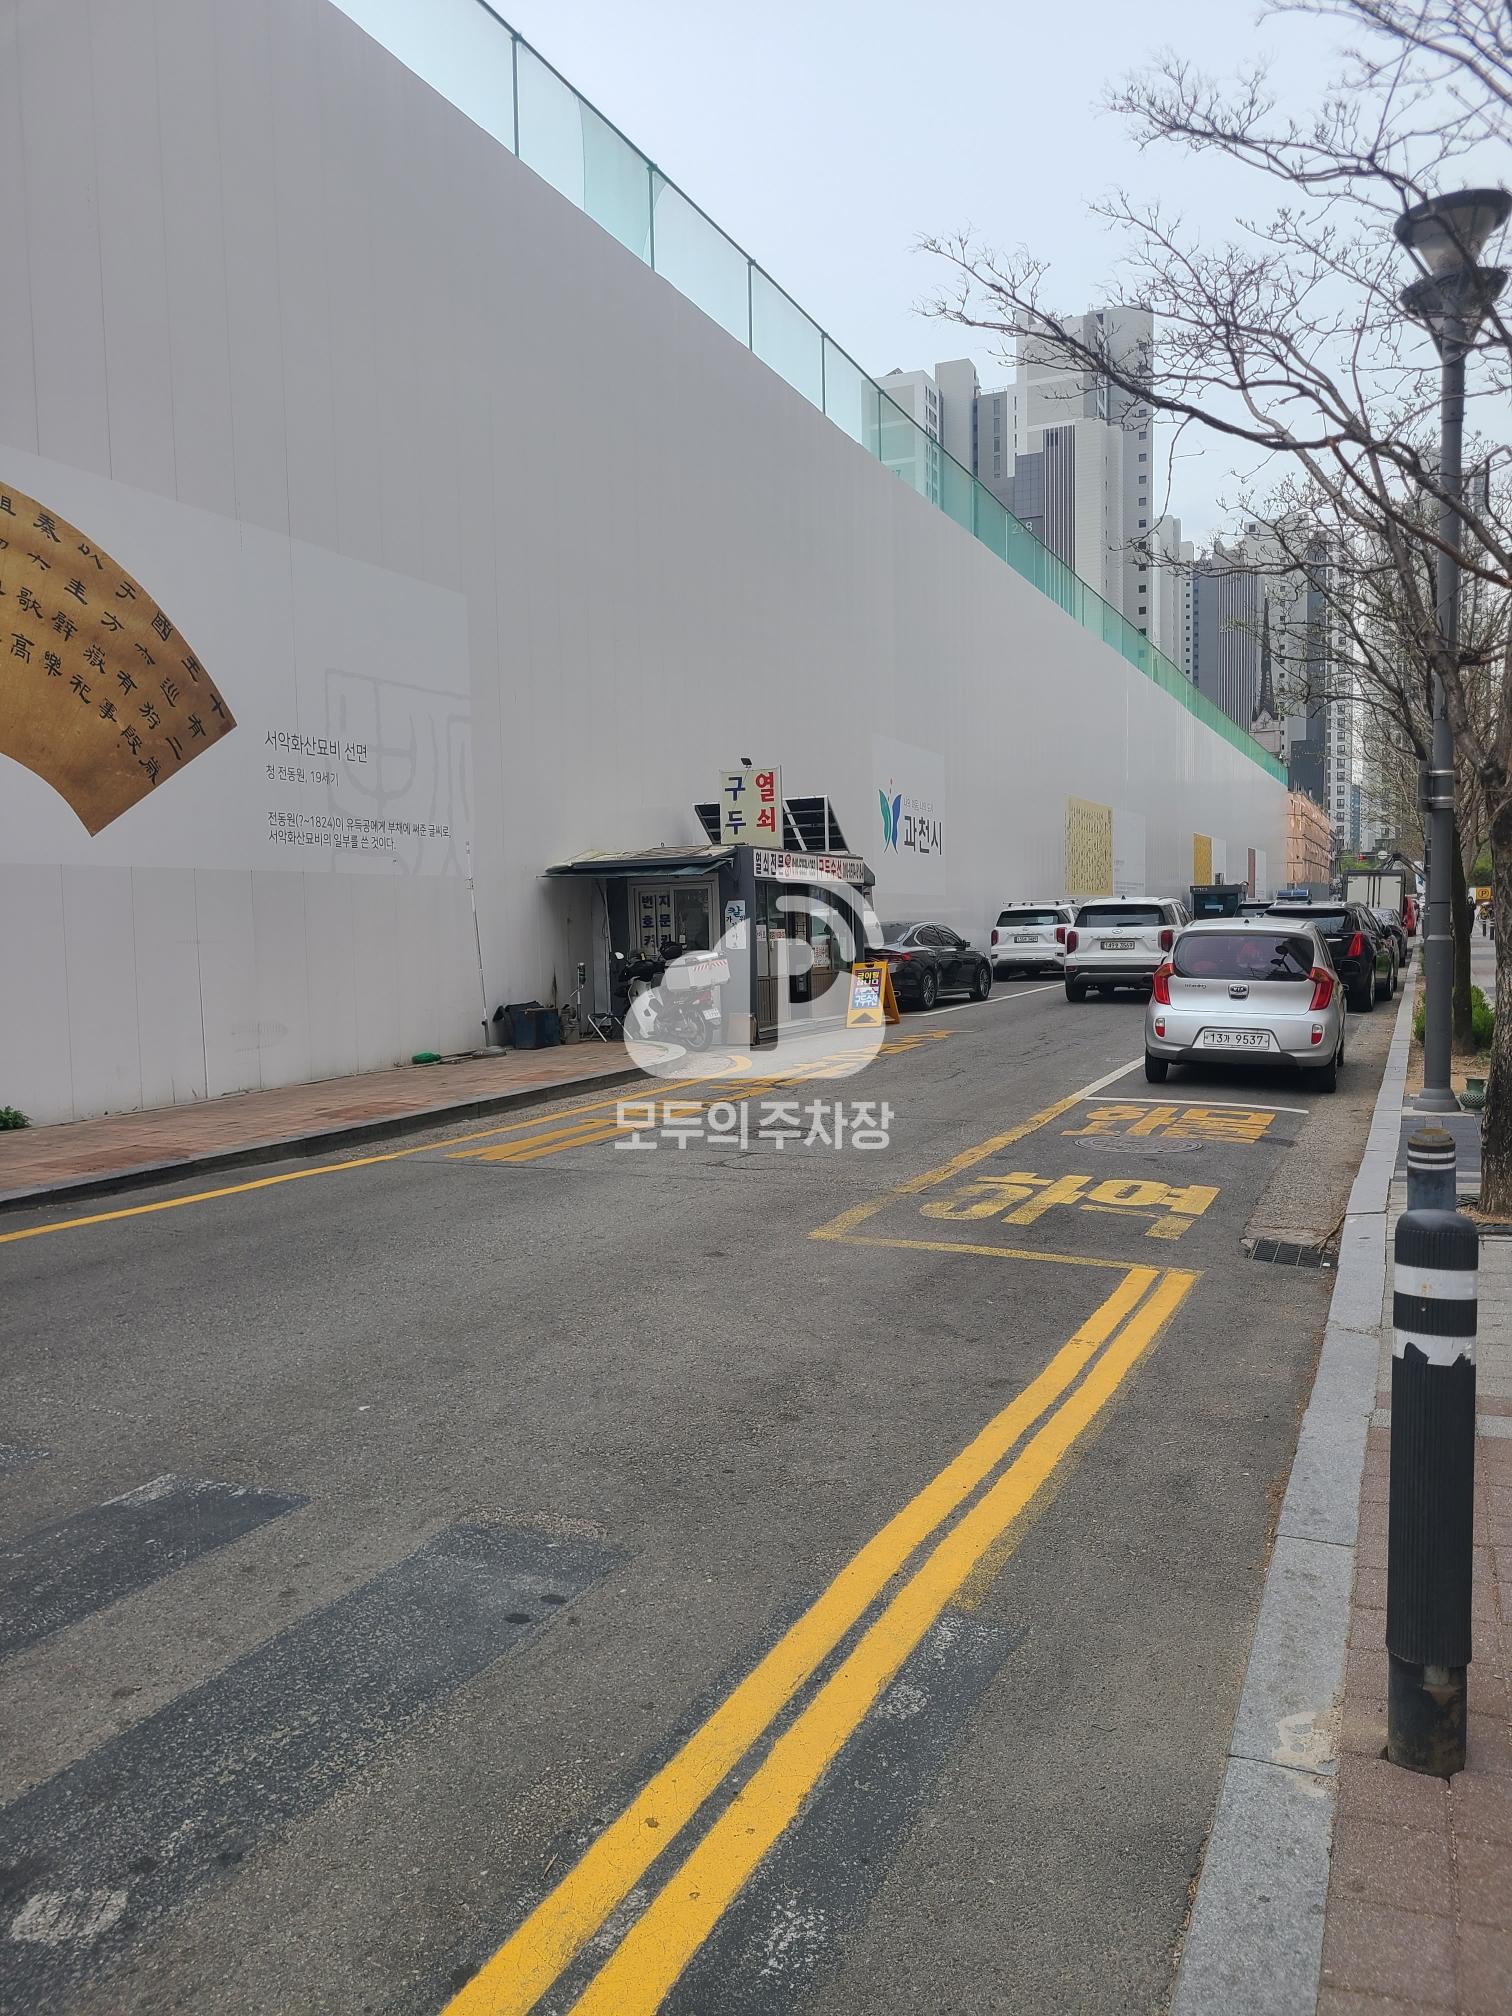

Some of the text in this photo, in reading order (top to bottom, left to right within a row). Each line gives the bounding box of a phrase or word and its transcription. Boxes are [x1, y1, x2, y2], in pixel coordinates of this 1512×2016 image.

[264, 730, 368, 763] 서악화산묘비 선면
[265, 764, 275, 780] 청
[310, 770, 339, 787] 19세기
[725, 776, 747, 835] 구두
[755, 771, 776, 832] 열쇠
[268, 829, 332, 847] 서악화산묘비의
[333, 834, 358, 849] 일부를
[360, 836, 370, 849] 쓴
[346, 818, 386, 834] 유득공에게
[388, 821, 411, 836] 부채에
[903, 815, 942, 855] 과천시
[1210, 1033, 1264, 1046] 13가 9537
[919, 1172, 1221, 1240] 하역
